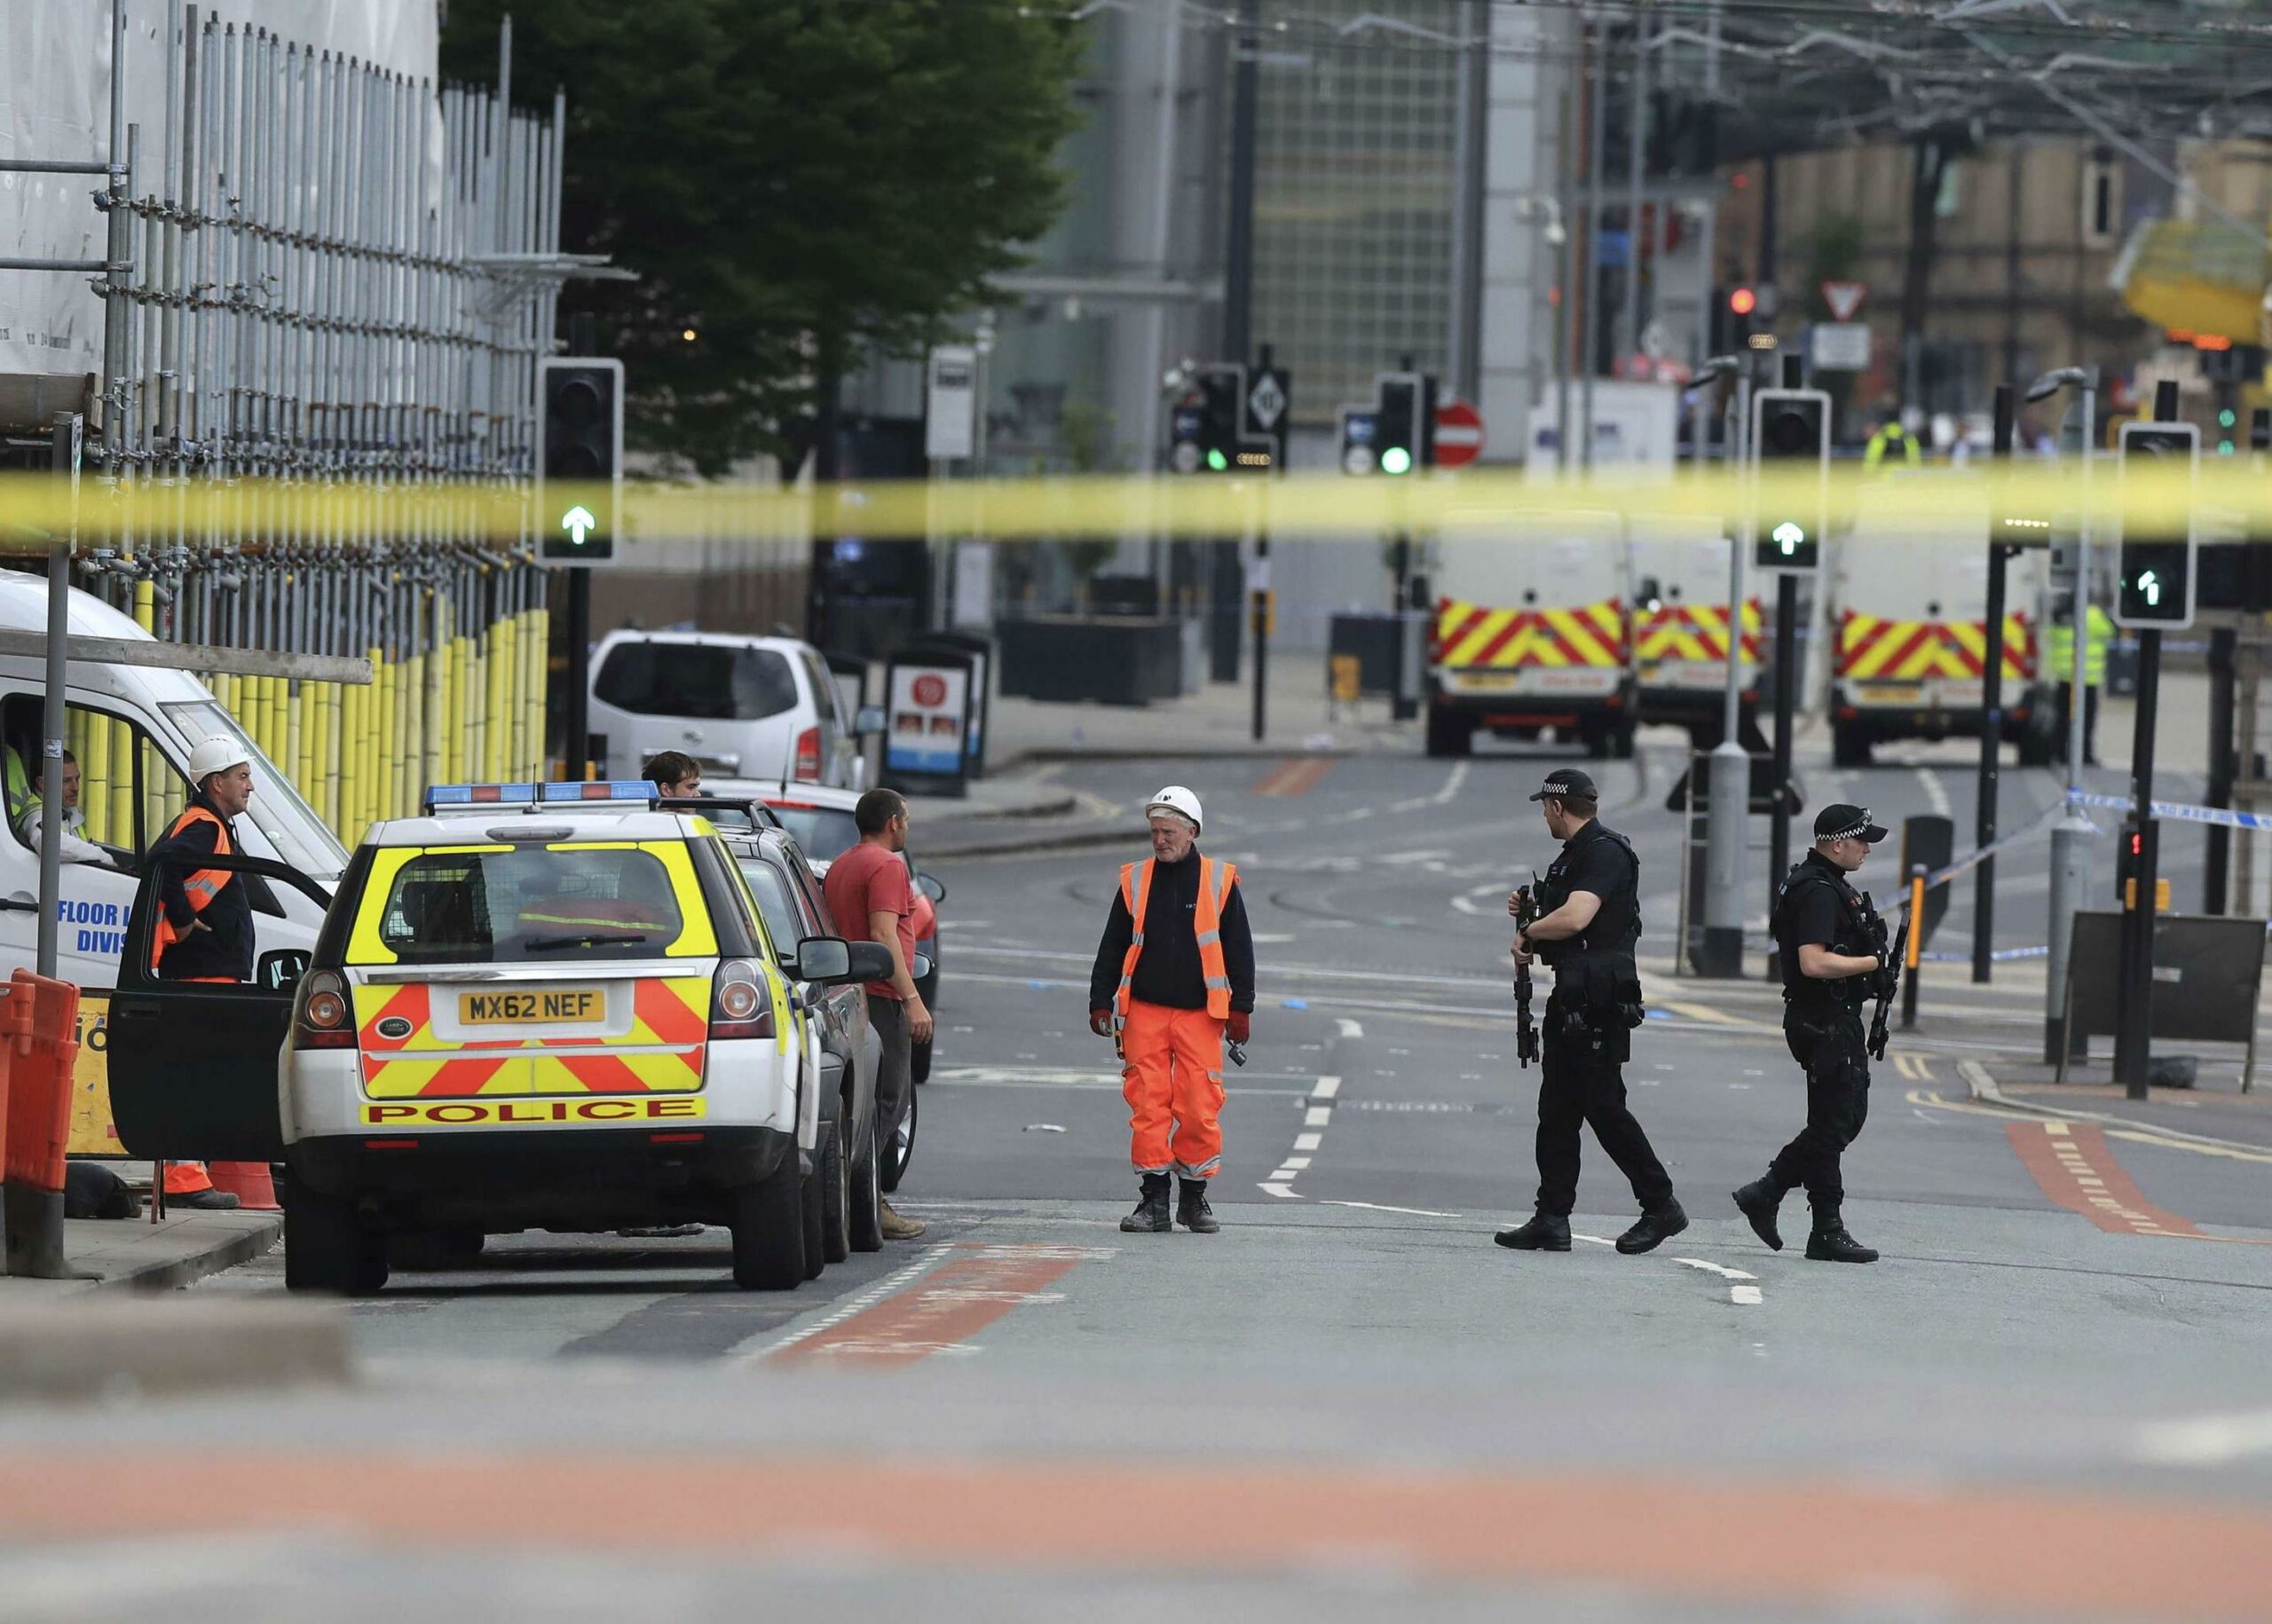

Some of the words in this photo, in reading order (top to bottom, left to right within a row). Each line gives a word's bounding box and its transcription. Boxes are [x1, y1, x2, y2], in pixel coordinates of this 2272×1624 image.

[58, 900, 118, 926] FLOOR
[470, 995, 536, 1020] MX62
[544, 993, 593, 1017] NEF
[368, 1100, 696, 1123] POLICE
